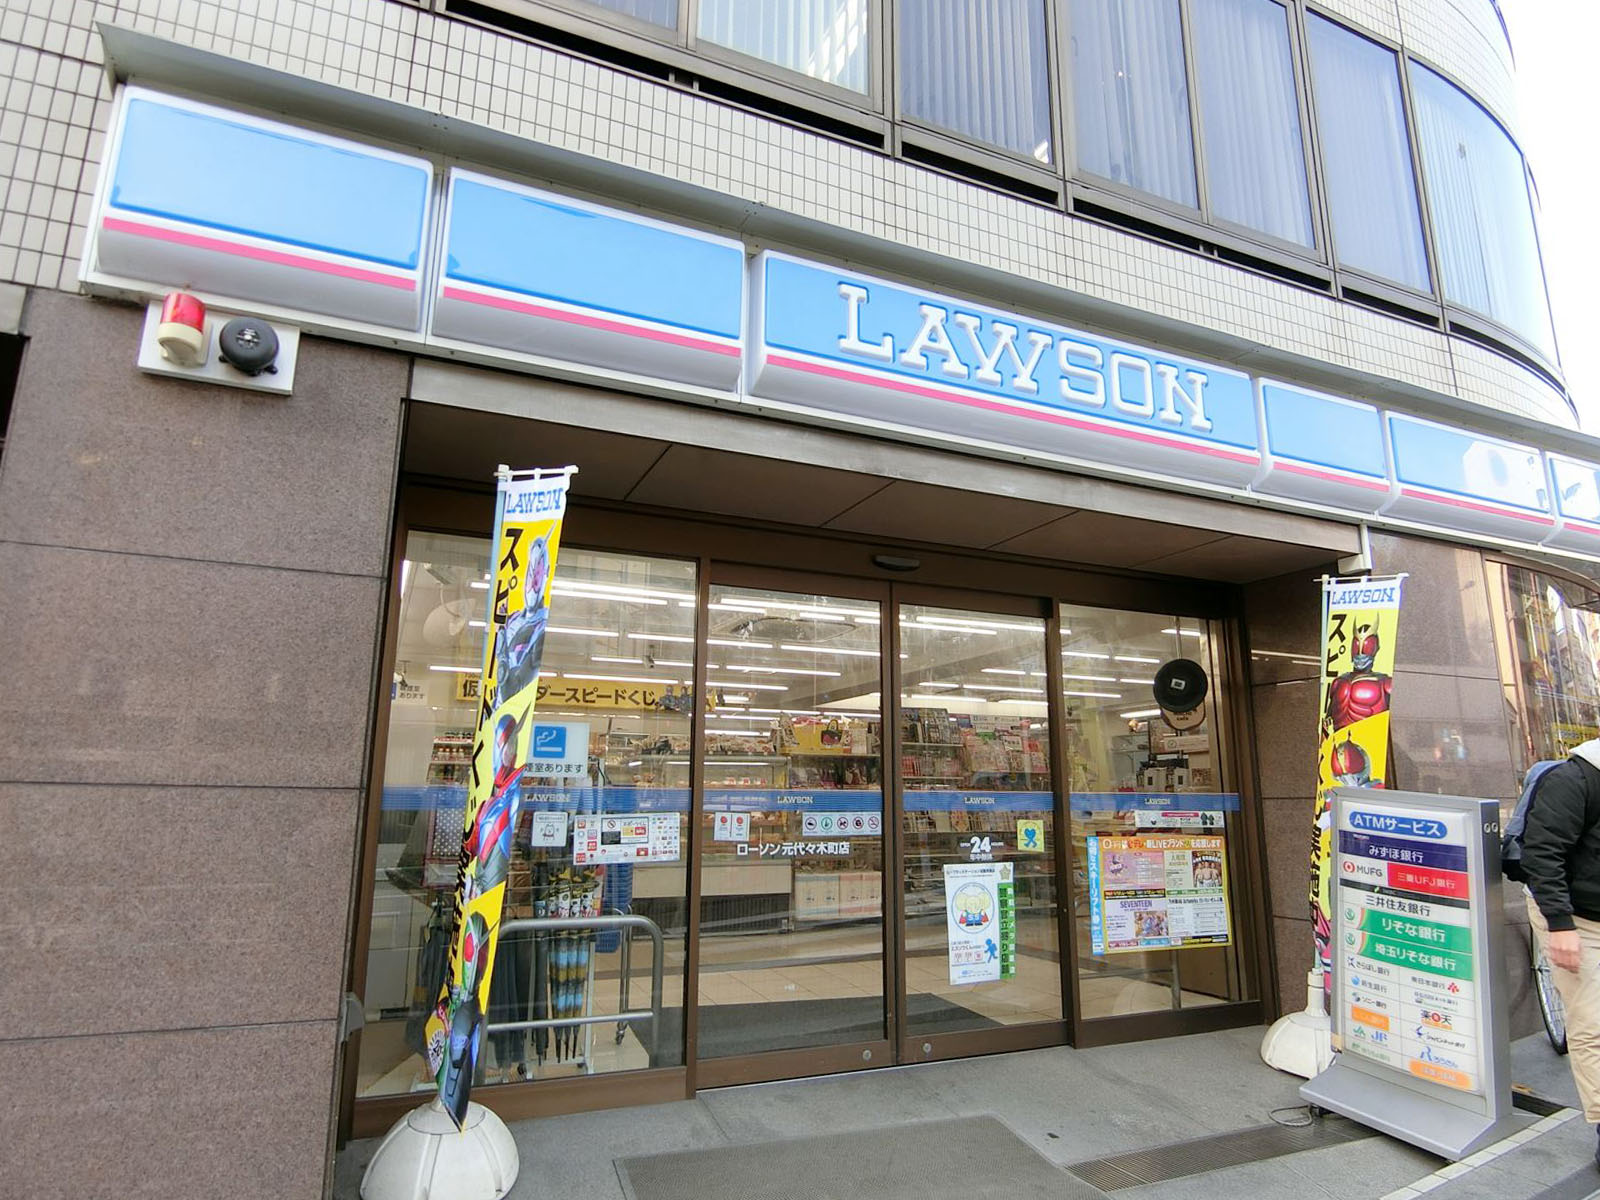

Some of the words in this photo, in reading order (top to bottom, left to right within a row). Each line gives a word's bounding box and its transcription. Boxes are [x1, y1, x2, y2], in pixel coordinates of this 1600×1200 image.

[837, 282, 1213, 434] LAWSON
[505, 487, 564, 514] LAWSON
[1331, 587, 1395, 605] LAWSON
[524, 793, 571, 802] LAWSON
[777, 795, 814, 804] LAWSON
[963, 796, 996, 805] LAWSON
[1353, 815, 1441, 837] ATMサービス
[737, 841, 850, 856] ローソン元代々木町店
[970, 836, 992, 853] 24
[1368, 844, 1424, 863] みずほ銀行
[1356, 864, 1383, 877] MUFG
[1397, 872, 1456, 890] 三菱UFJ銀行
[1120, 899, 1153, 909] SEVENTEEN
[1366, 895, 1431, 917] 三井住友銀行
[1382, 918, 1446, 942] りそな銀行
[1375, 943, 1456, 972] 埼玉りそな銀行
